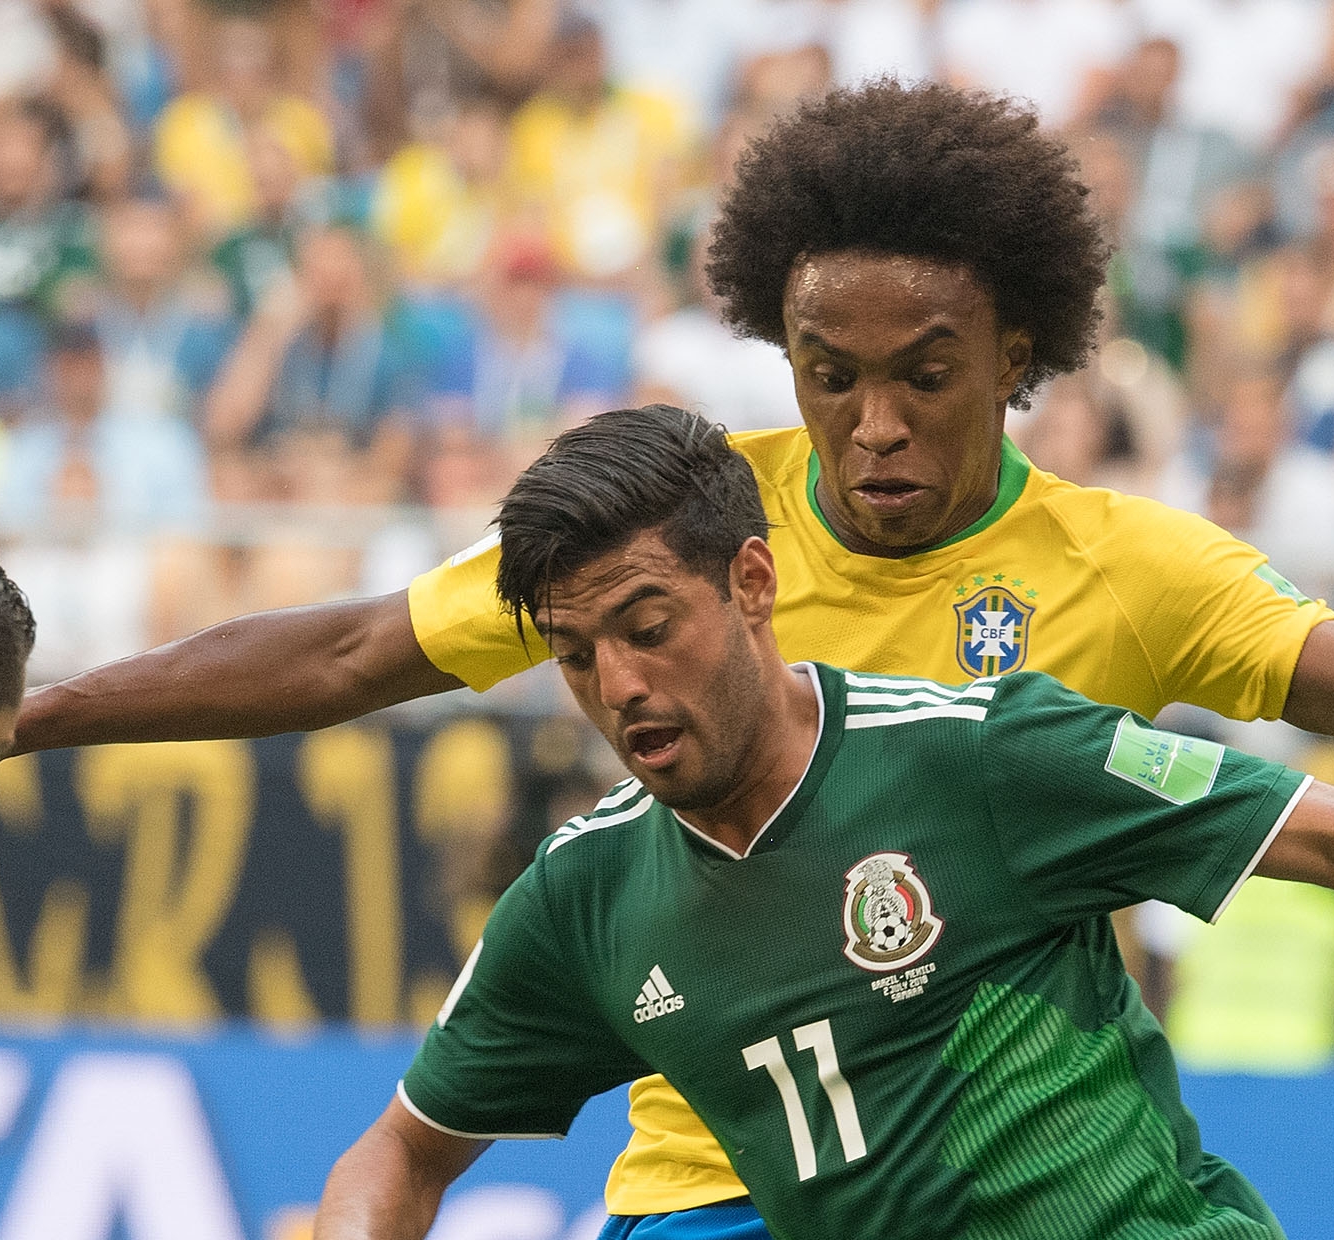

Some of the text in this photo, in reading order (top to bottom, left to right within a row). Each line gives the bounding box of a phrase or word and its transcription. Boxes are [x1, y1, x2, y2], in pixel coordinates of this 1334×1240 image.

[980, 628, 1007, 640] CBF
[1137, 733, 1160, 779] LIVI
[871, 974, 899, 991] BRAZIL
[905, 962, 936, 980] MEXICO
[633, 994, 685, 1023] adidas
[742, 1018, 867, 1181] 11
